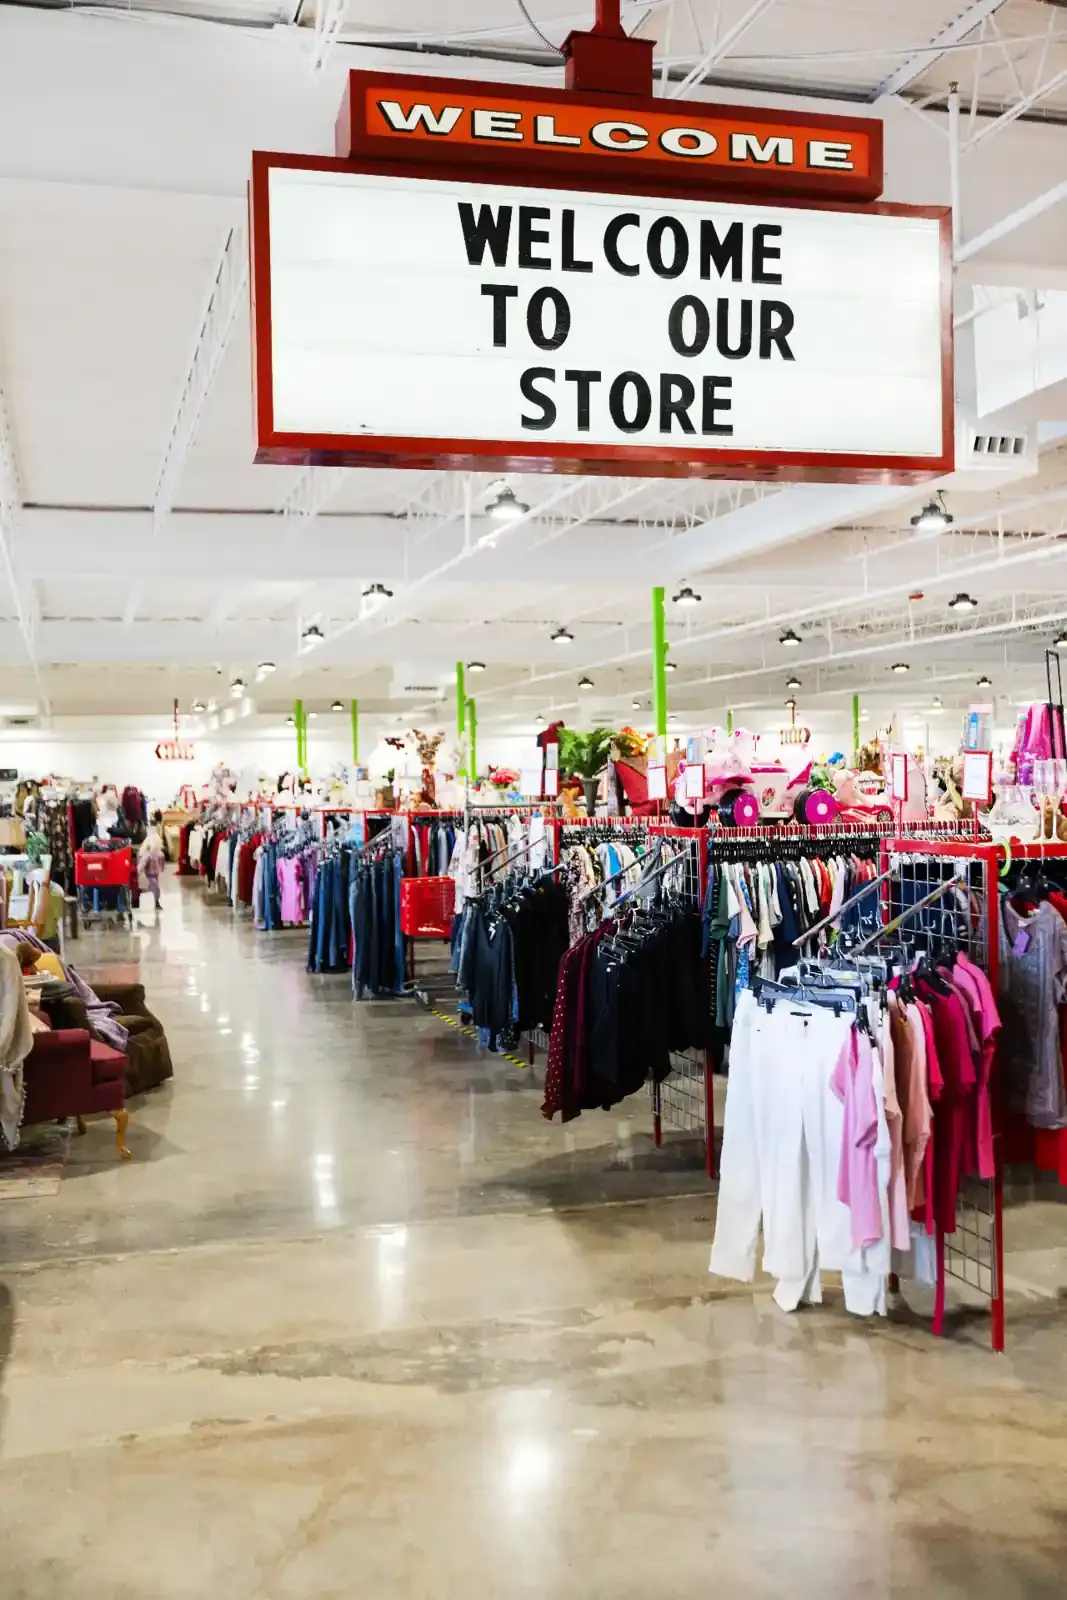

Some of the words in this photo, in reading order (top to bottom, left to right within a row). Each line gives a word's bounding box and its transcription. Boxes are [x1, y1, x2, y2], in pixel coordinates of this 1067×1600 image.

[378, 101, 854, 170] WELCOME
[457, 203, 783, 285] WELCOME
[481, 284, 571, 351] TO
[669, 294, 796, 361] OUR
[520, 367, 734, 436] STORE
